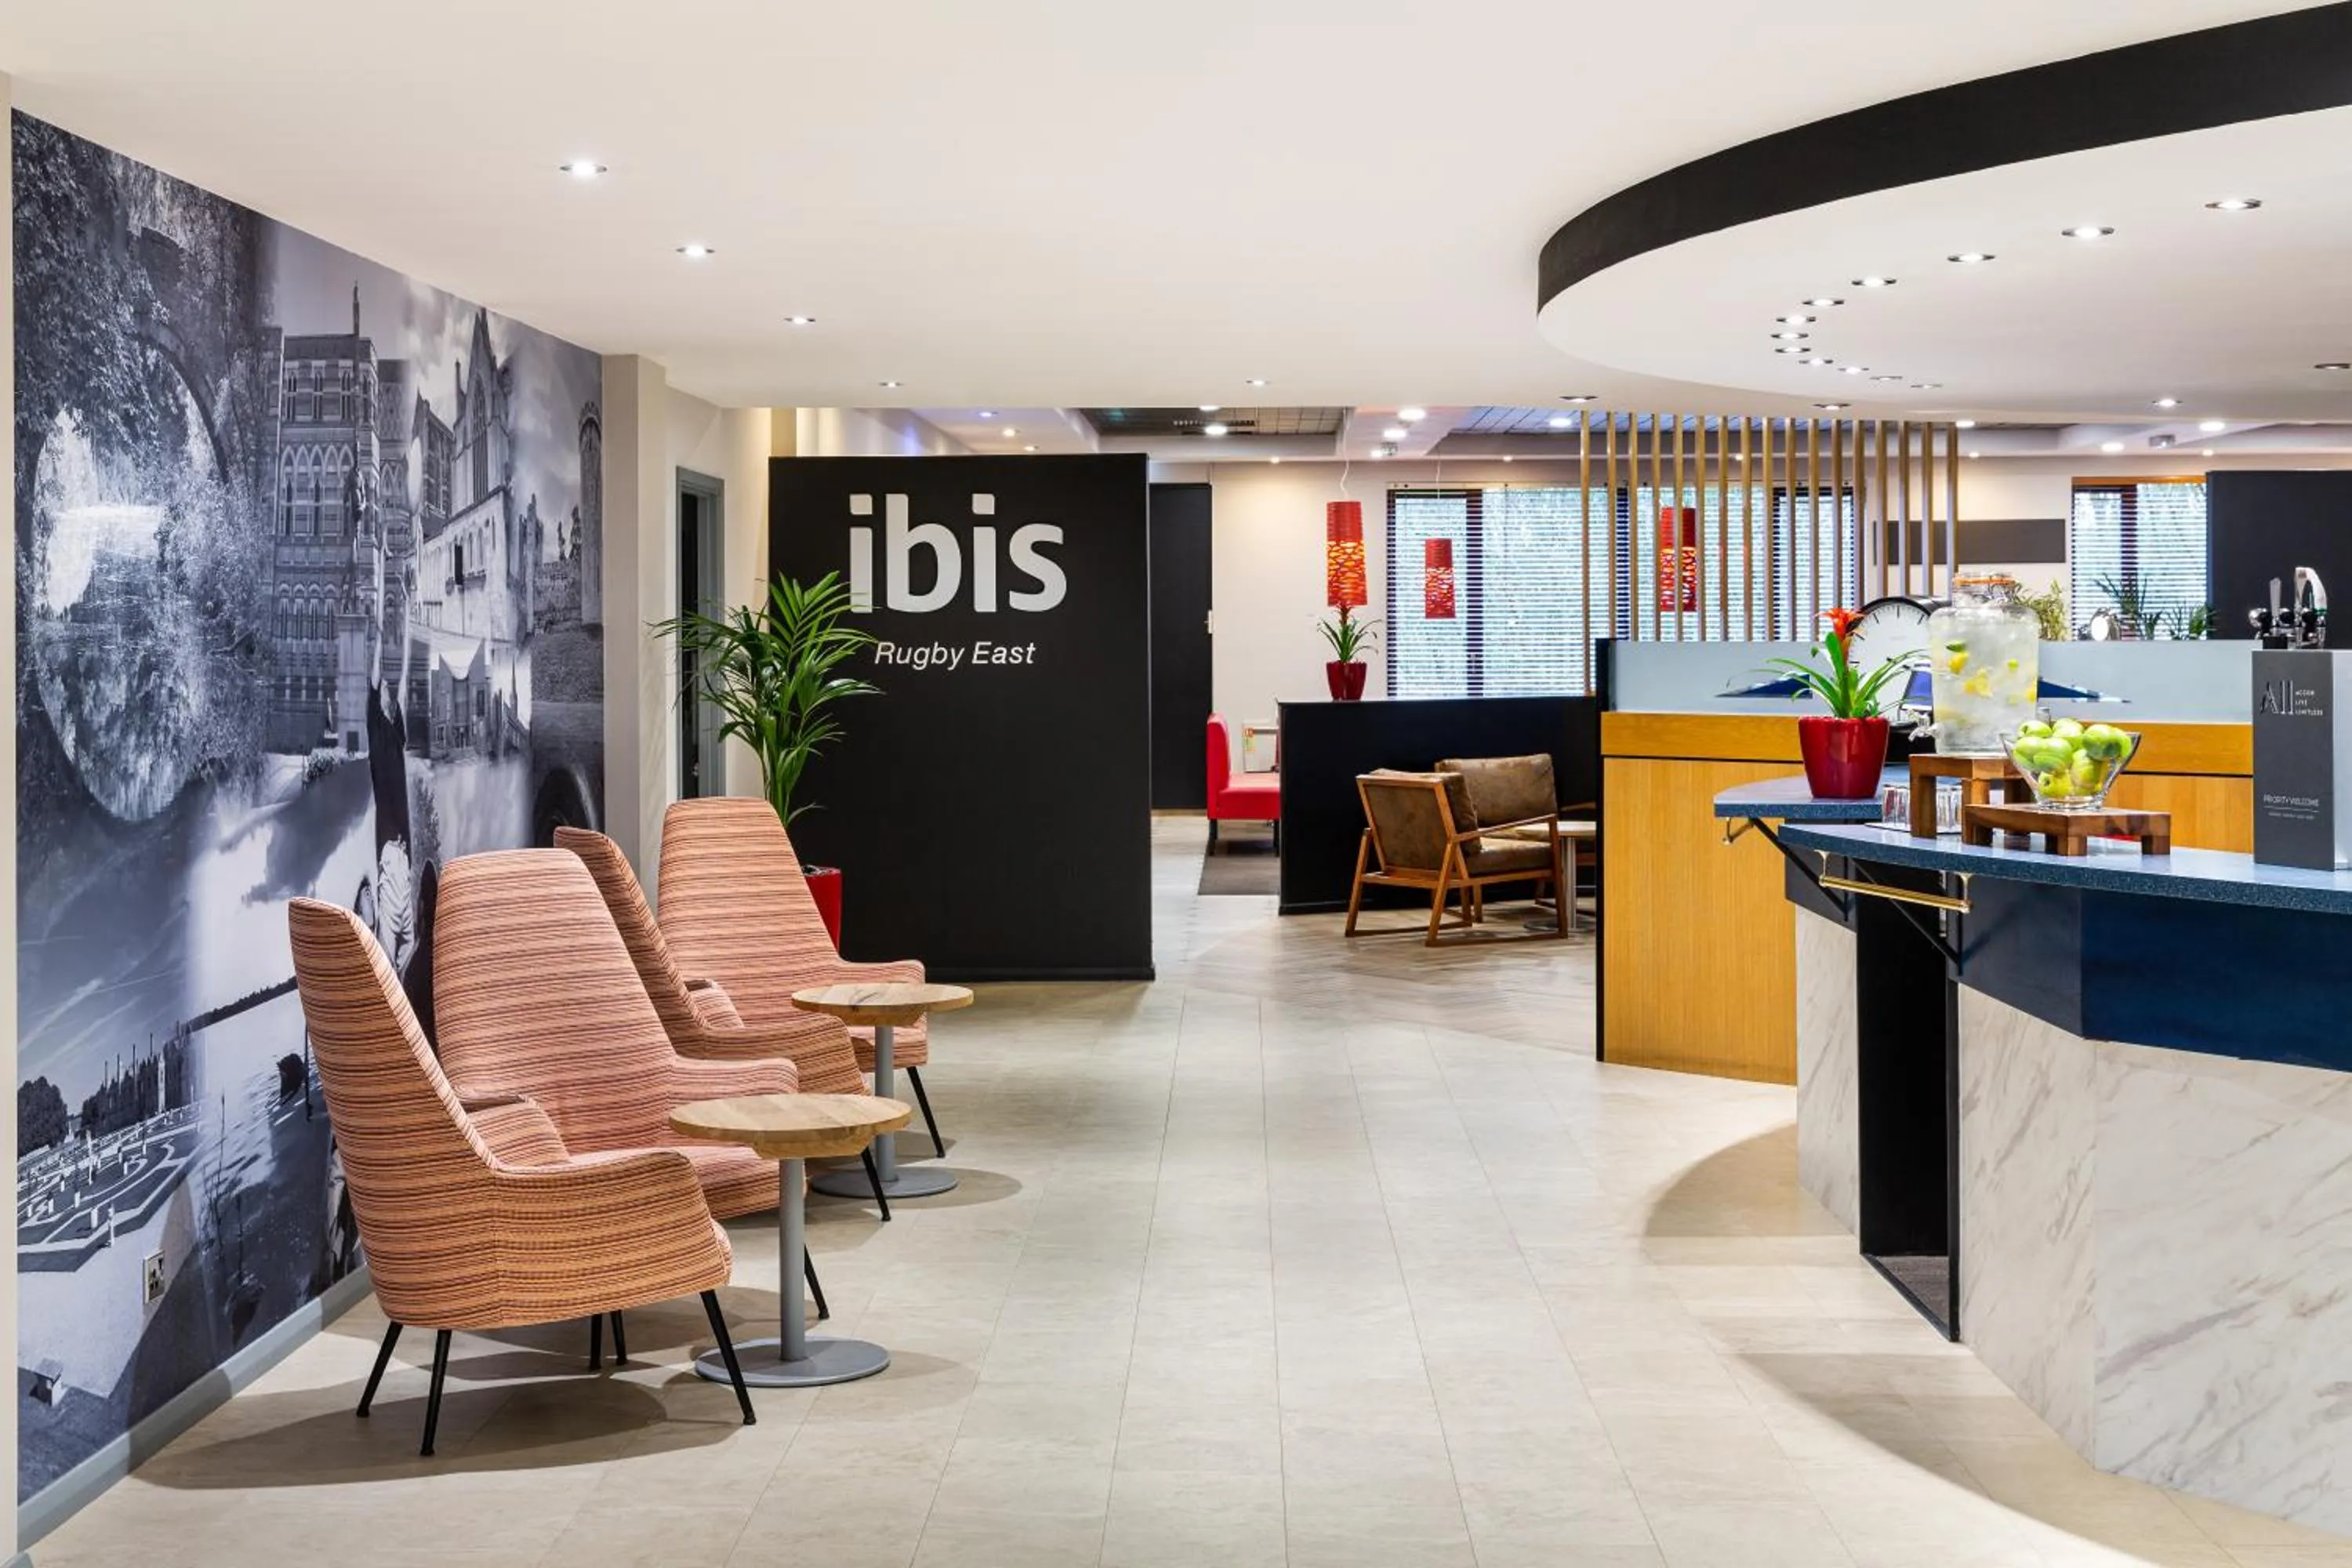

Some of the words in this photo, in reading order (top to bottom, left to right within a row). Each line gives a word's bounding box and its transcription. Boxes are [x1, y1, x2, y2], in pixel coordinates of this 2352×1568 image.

[849, 493, 1067, 613] ibis
[874, 641, 965, 670] Rugby
[971, 641, 1036, 664] East
